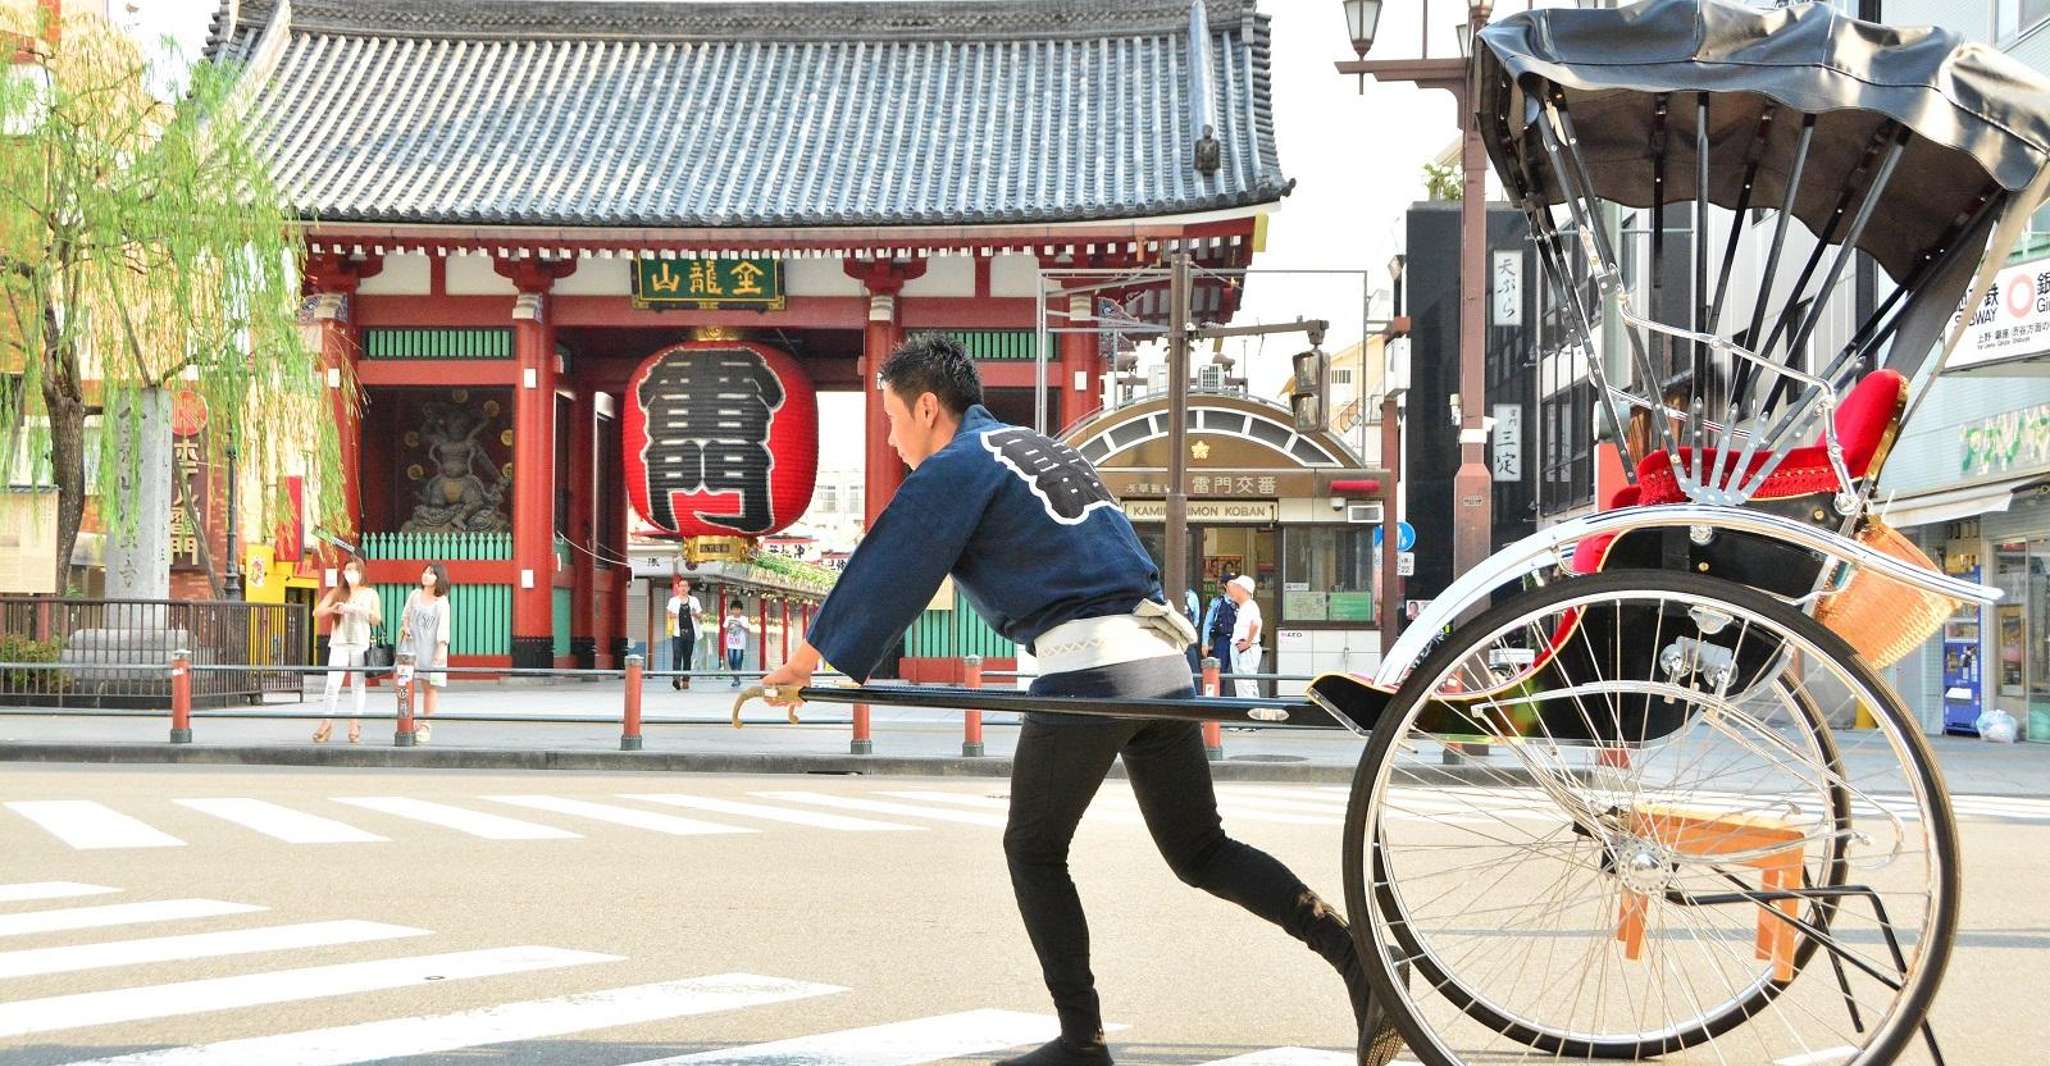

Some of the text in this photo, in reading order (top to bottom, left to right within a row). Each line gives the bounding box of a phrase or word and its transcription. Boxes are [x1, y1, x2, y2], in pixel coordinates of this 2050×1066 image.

[1497, 258, 1516, 318] 天ぷら
[637, 347, 787, 534] 雷門
[1496, 430, 1517, 475] 三定
[1191, 475, 1277, 495] 雷門交番
[1225, 507, 1266, 517] KOBAN
